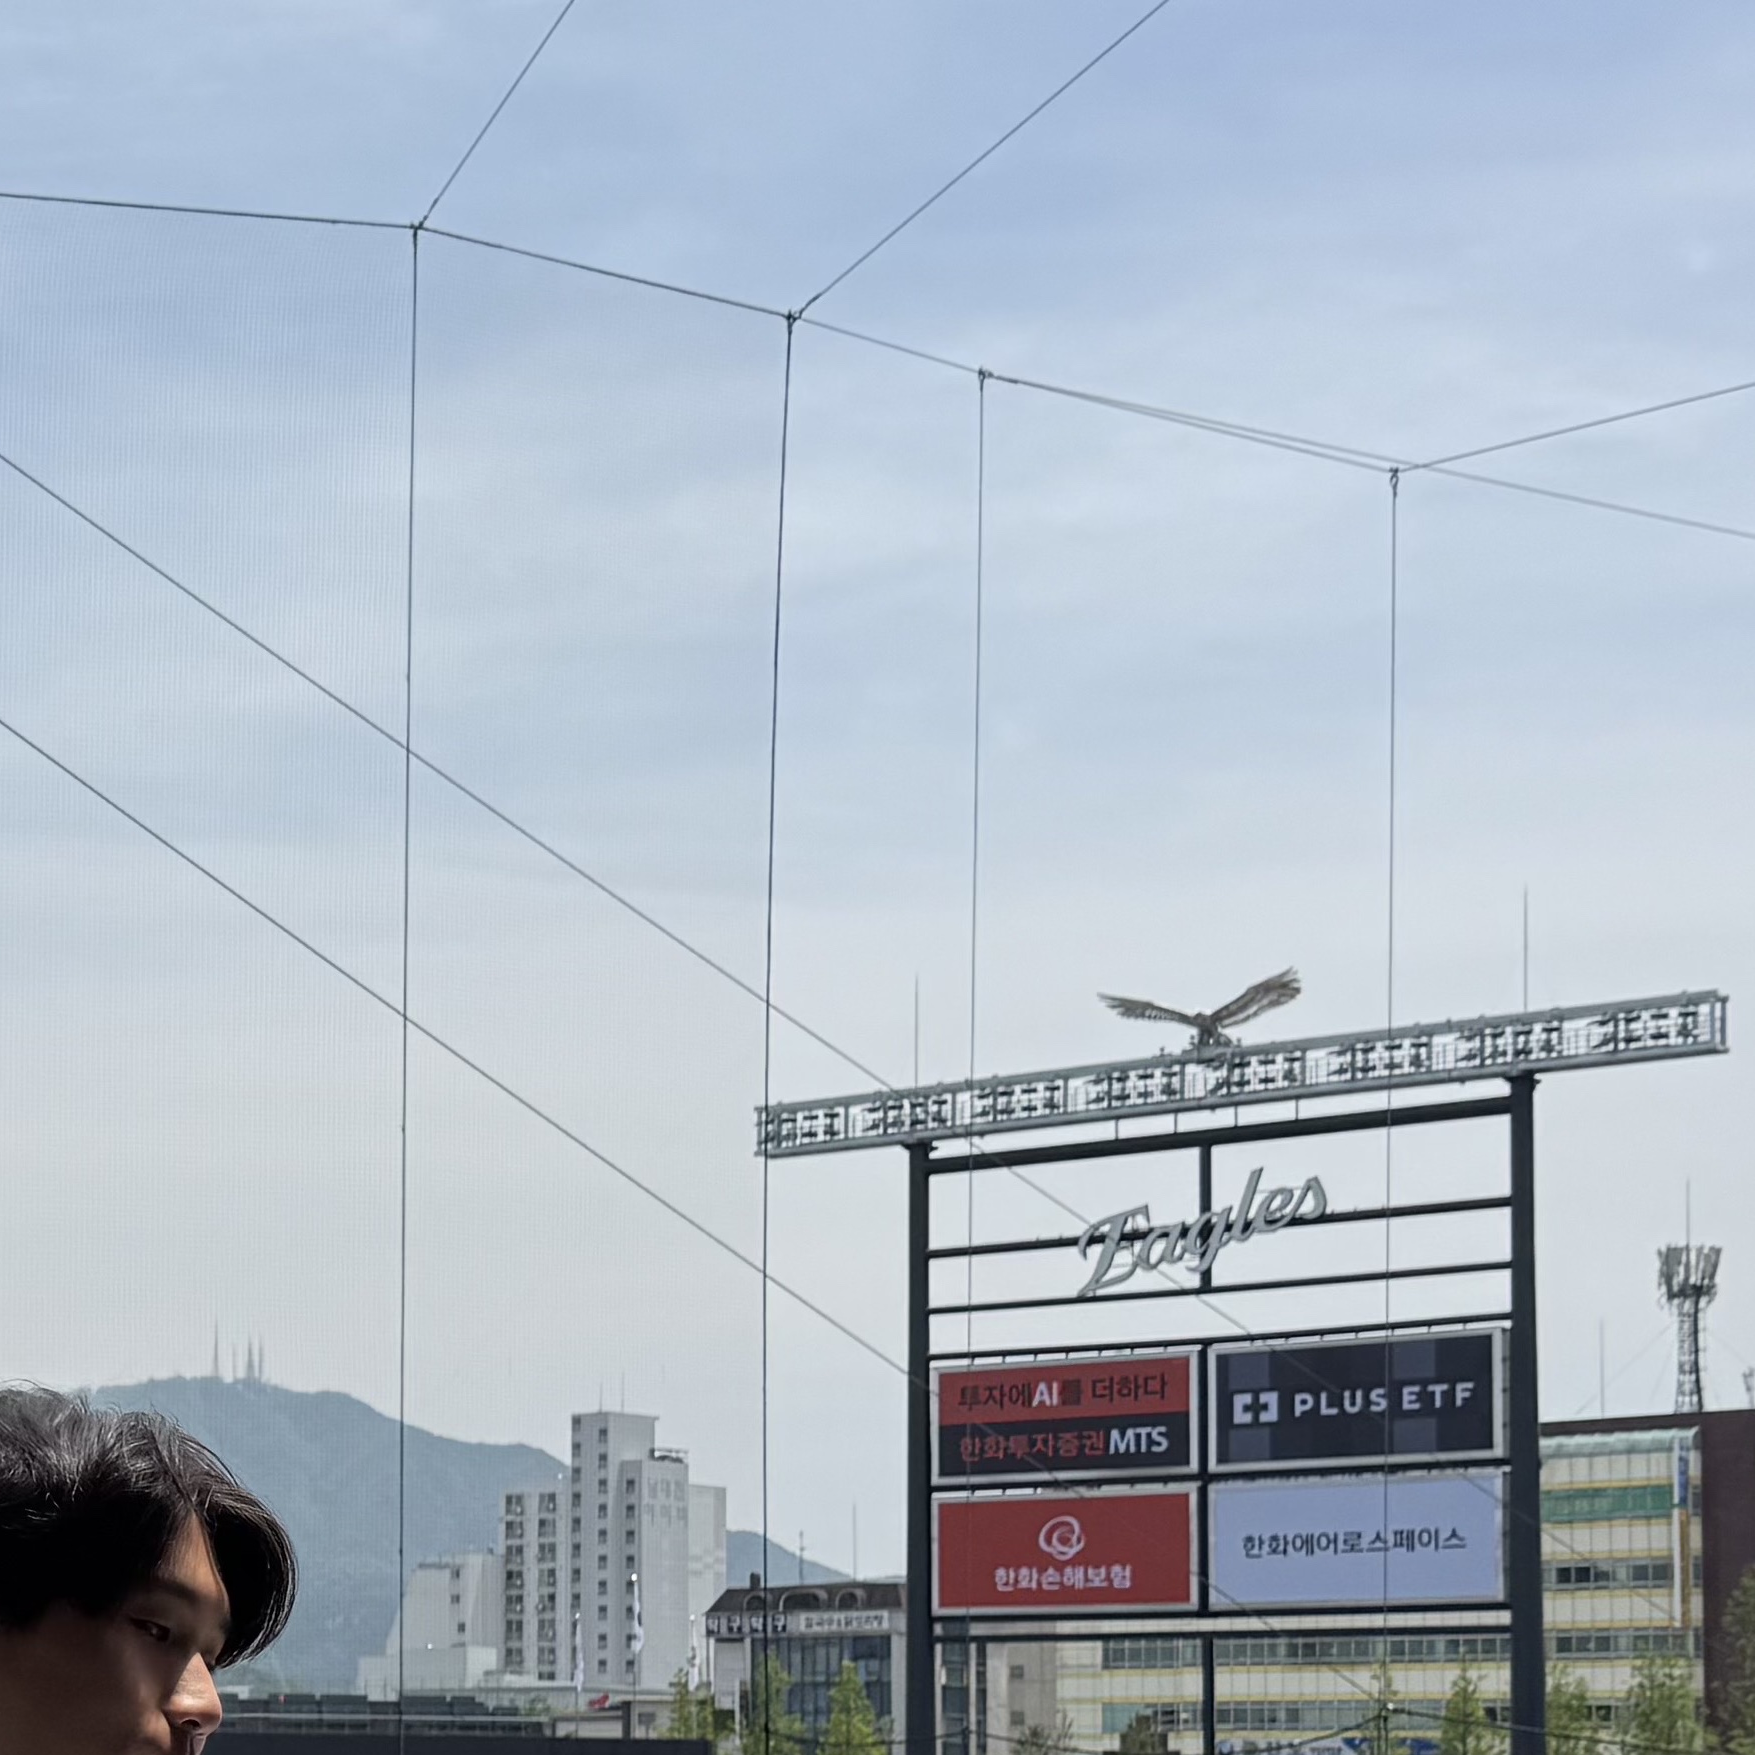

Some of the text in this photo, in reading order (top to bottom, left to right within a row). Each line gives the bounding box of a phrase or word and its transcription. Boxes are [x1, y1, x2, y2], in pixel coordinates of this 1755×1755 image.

[1076, 1166, 1328, 1298] Eagles
[957, 1372, 1169, 1411] 투자에AI를 더하다
[1293, 1380, 1475, 1418] PLUS ETF
[958, 1425, 1169, 1463] 한화투자증권 MTS
[1242, 1525, 1468, 1561] 한화에어로스페이스
[993, 1563, 1132, 1592] 한화손해보험
